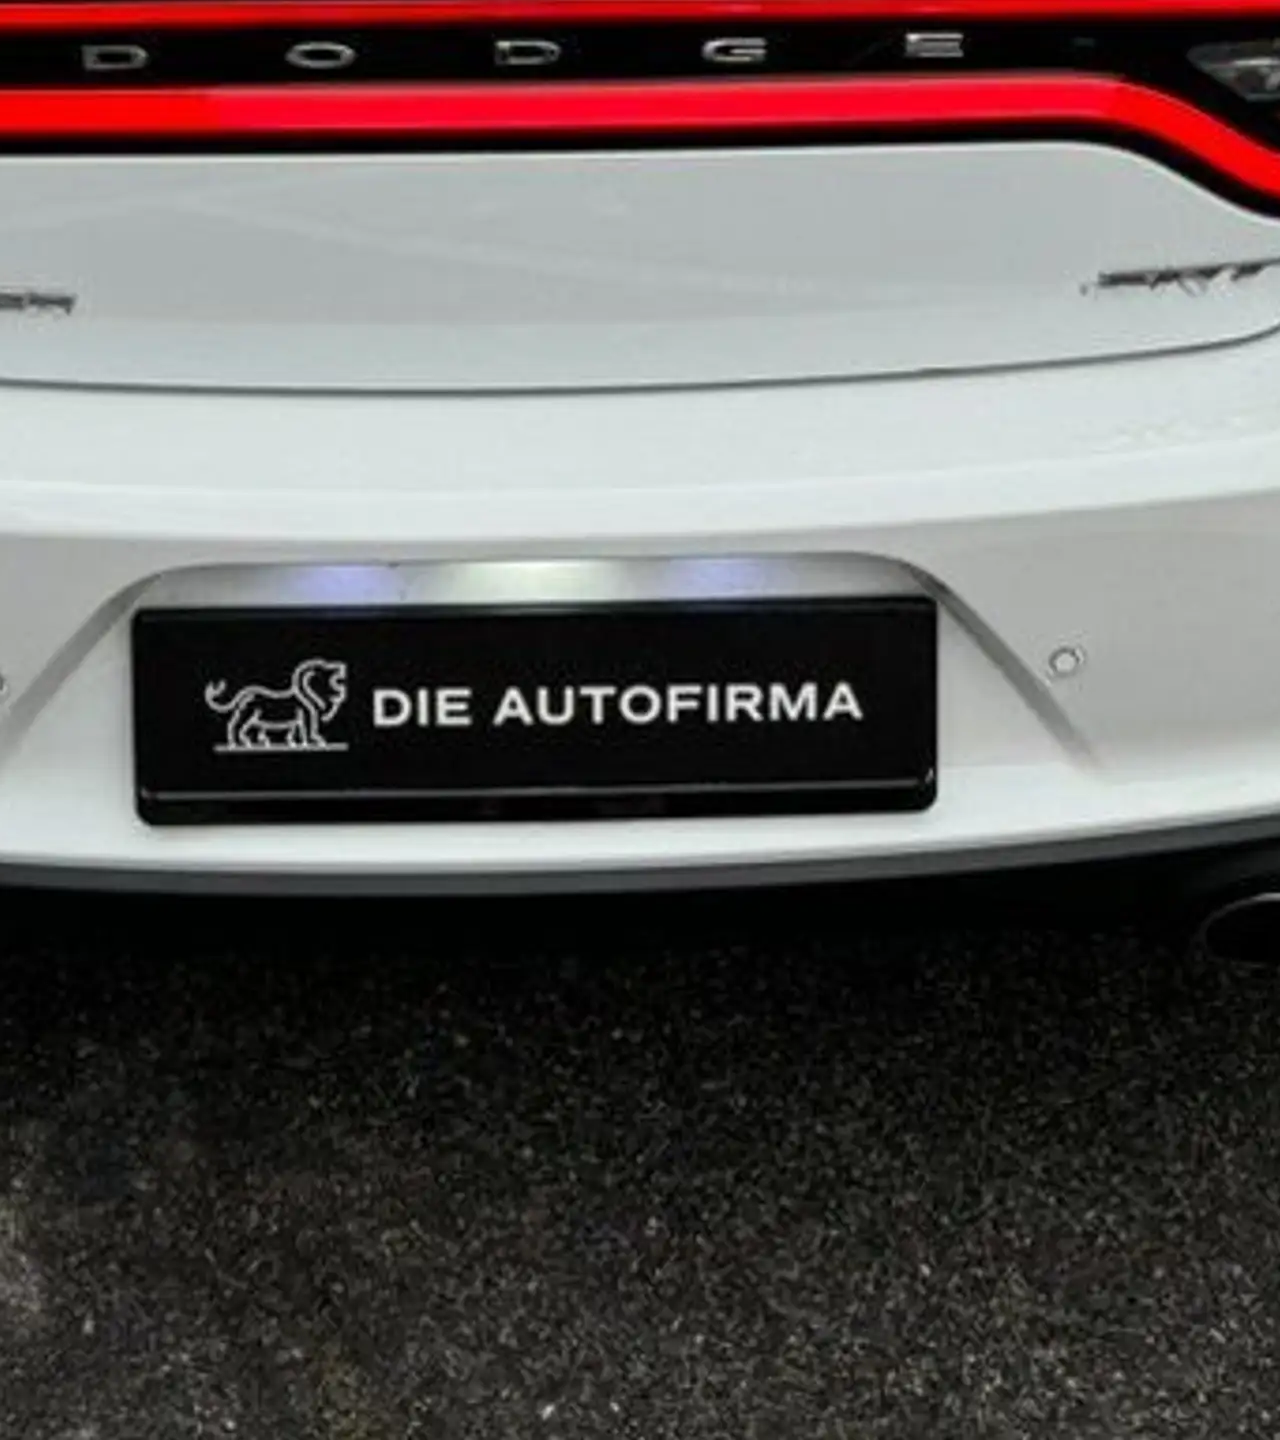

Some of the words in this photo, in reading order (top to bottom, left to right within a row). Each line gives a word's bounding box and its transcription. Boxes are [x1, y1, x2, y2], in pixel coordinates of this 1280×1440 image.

[82, 32, 964, 71] DODGE
[373, 687, 474, 728] DIE
[492, 680, 864, 725] AUTOFIRMA
